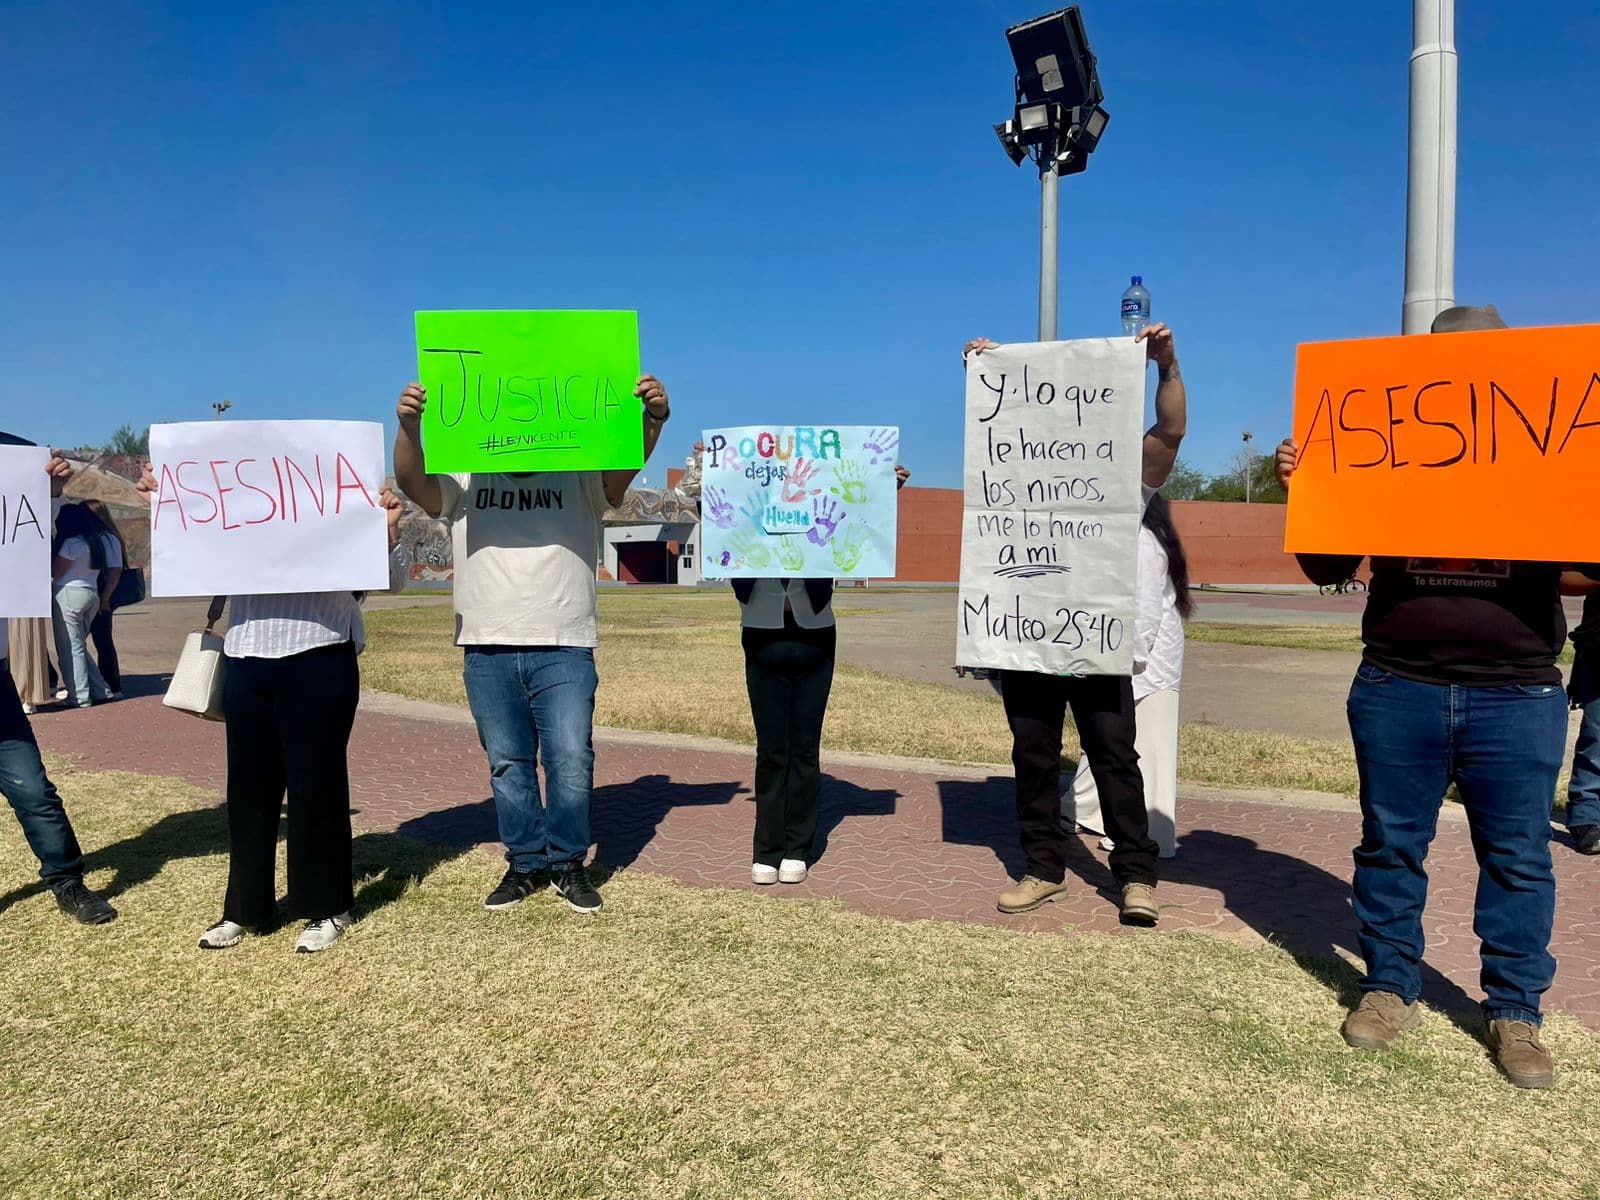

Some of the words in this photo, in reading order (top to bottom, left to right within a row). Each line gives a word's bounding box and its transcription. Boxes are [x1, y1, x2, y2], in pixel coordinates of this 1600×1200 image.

[423, 348, 623, 427] JUSTICIA
[1023, 364, 1055, 405] lo
[1065, 385, 1114, 427] que
[1294, 372, 1600, 474] ASESINA
[707, 427, 842, 472] PROCURA
[988, 426, 1012, 467] le
[1019, 427, 1086, 461] hacen
[1096, 440, 1114, 462] a
[153, 452, 376, 531] ASESINA
[744, 460, 790, 487] dejar
[982, 470, 1016, 507] los
[1027, 475, 1105, 502] niños,
[475, 487, 515, 510] OLD
[518, 488, 563, 511] NAVY
[765, 505, 810, 528] Huella
[977, 514, 1014, 538] me
[1022, 508, 1040, 539] lo
[1049, 511, 1103, 540] hacen
[998, 544, 1016, 566] a
[1413, 576, 1426, 586] Te
[963, 594, 1046, 644] Mateo
